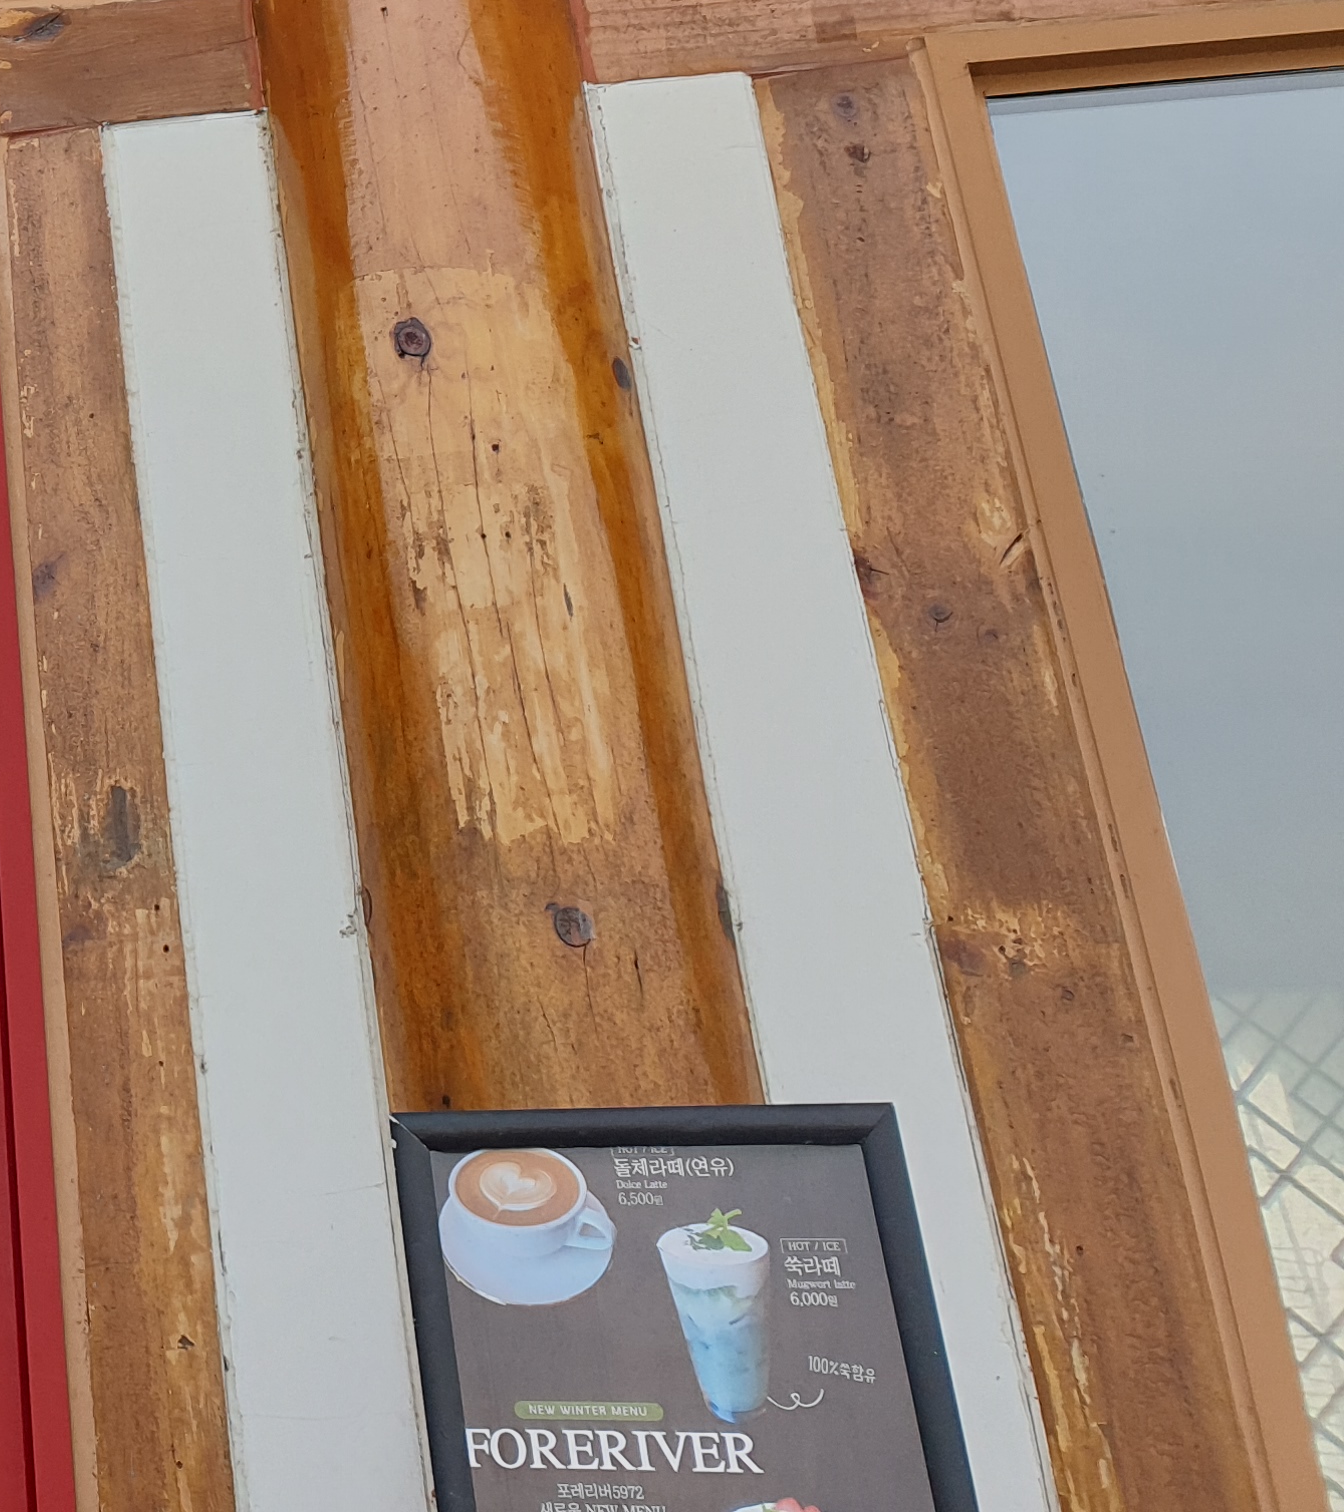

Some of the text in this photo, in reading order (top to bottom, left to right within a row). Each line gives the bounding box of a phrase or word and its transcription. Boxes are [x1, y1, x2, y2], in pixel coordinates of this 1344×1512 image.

[614, 1155, 735, 1178] 돌체라떼(연유)
[788, 1241, 810, 1251] HOT
[823, 1241, 842, 1252] ICE
[784, 1255, 841, 1277] 쑥라떼
[790, 1291, 838, 1307] 6,000원
[528, 1404, 647, 1416] NEW WINTER MENU
[465, 1427, 765, 1474] FORERIVER
[557, 1483, 645, 1500] 포레리버5972
